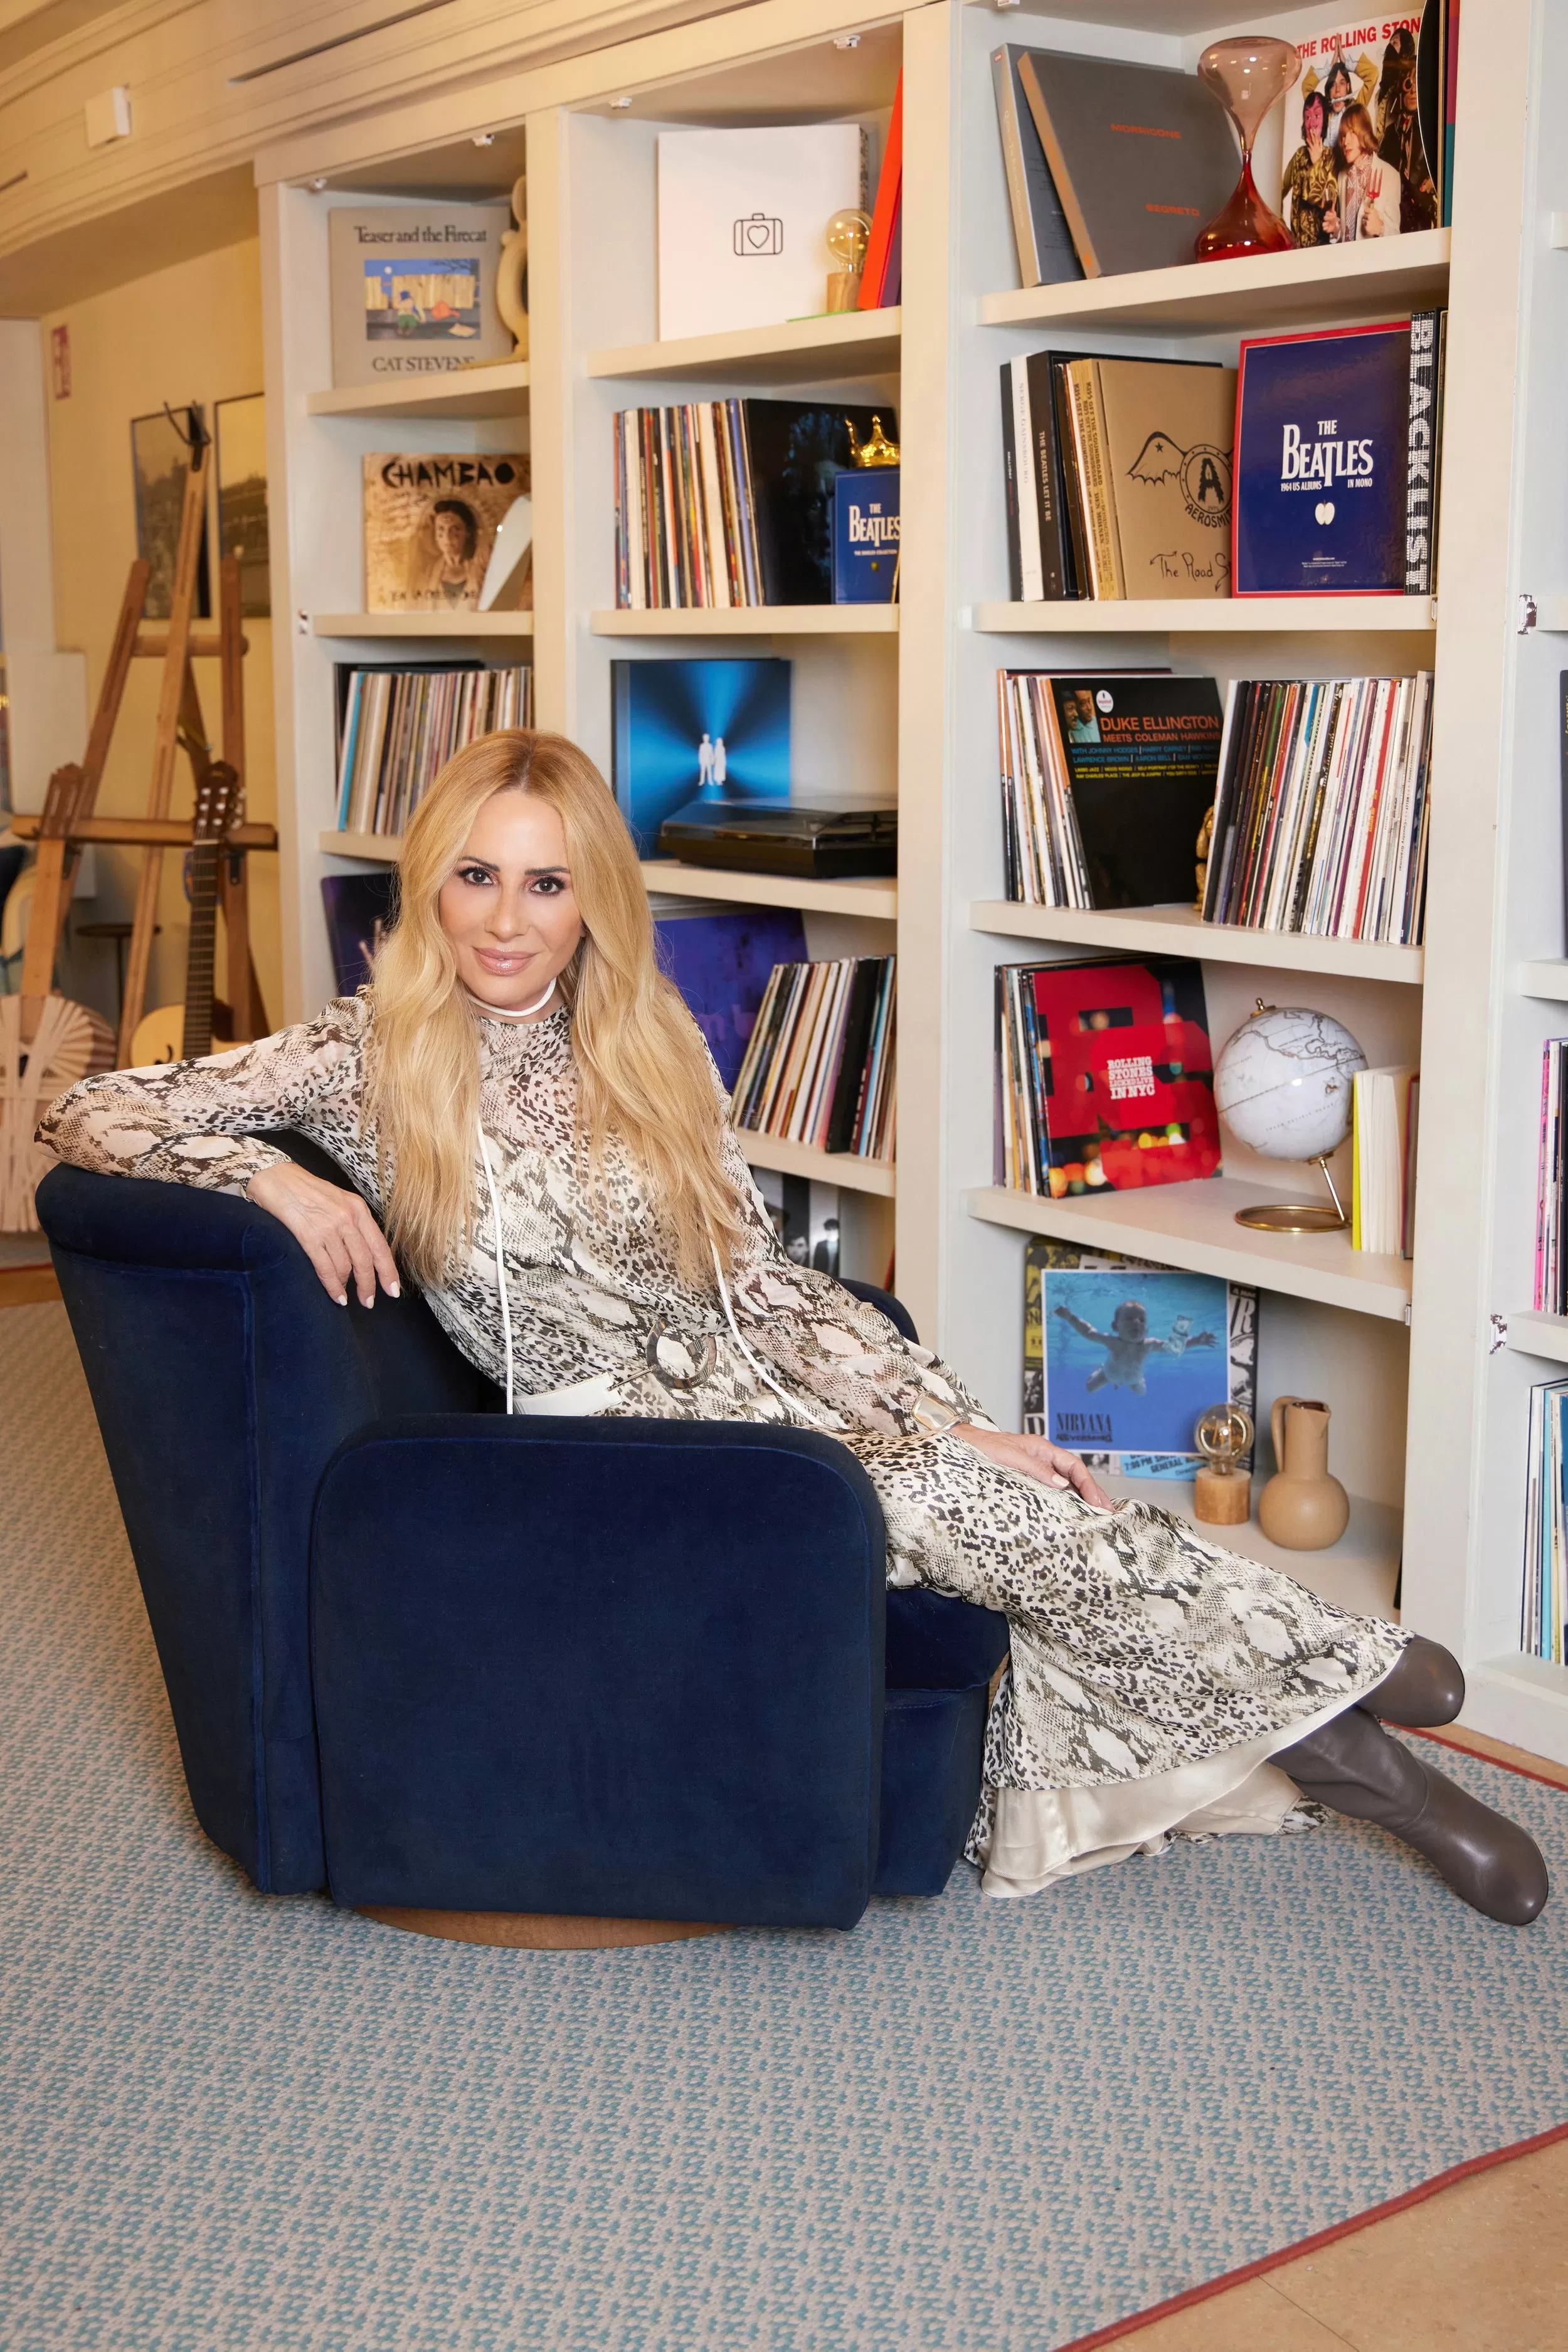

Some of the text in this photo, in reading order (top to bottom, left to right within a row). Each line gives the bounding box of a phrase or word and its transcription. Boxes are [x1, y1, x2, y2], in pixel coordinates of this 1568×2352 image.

[1296, 41, 1316, 59] THE
[1321, 26, 1377, 53] ROLLING
[1110, 124, 1182, 139] MORRICONE
[1145, 203, 1199, 216] SEGRETO
[354, 225, 487, 243] Teaser and the Firecat
[373, 356, 405, 371] CAT
[1318, 420, 1337, 435] THE
[1281, 424, 1374, 487] BEATLES
[1406, 319, 1434, 592] BLACKLIST
[381, 460, 515, 489] CHAMBAO
[1040, 449, 1049, 483] BEATLES
[1045, 511, 1051, 521] BE
[1281, 477, 1372, 492] 1964 US ALBUMS IN MONO
[869, 503, 881, 514] THE
[849, 505, 900, 547] BEATLES
[1154, 552, 1179, 580] The
[1182, 552, 1214, 582] Road
[1099, 715, 1219, 731] DUKE ELLINGTON
[1103, 732, 1220, 742] MEETS COLEMAN HAWKINS
[1107, 1056, 1152, 1070] ROLLING
[1109, 1067, 1153, 1080] STONES
[1110, 1084, 1155, 1100] IN NYC
[1056, 1412, 1111, 1431] NIRVANA
